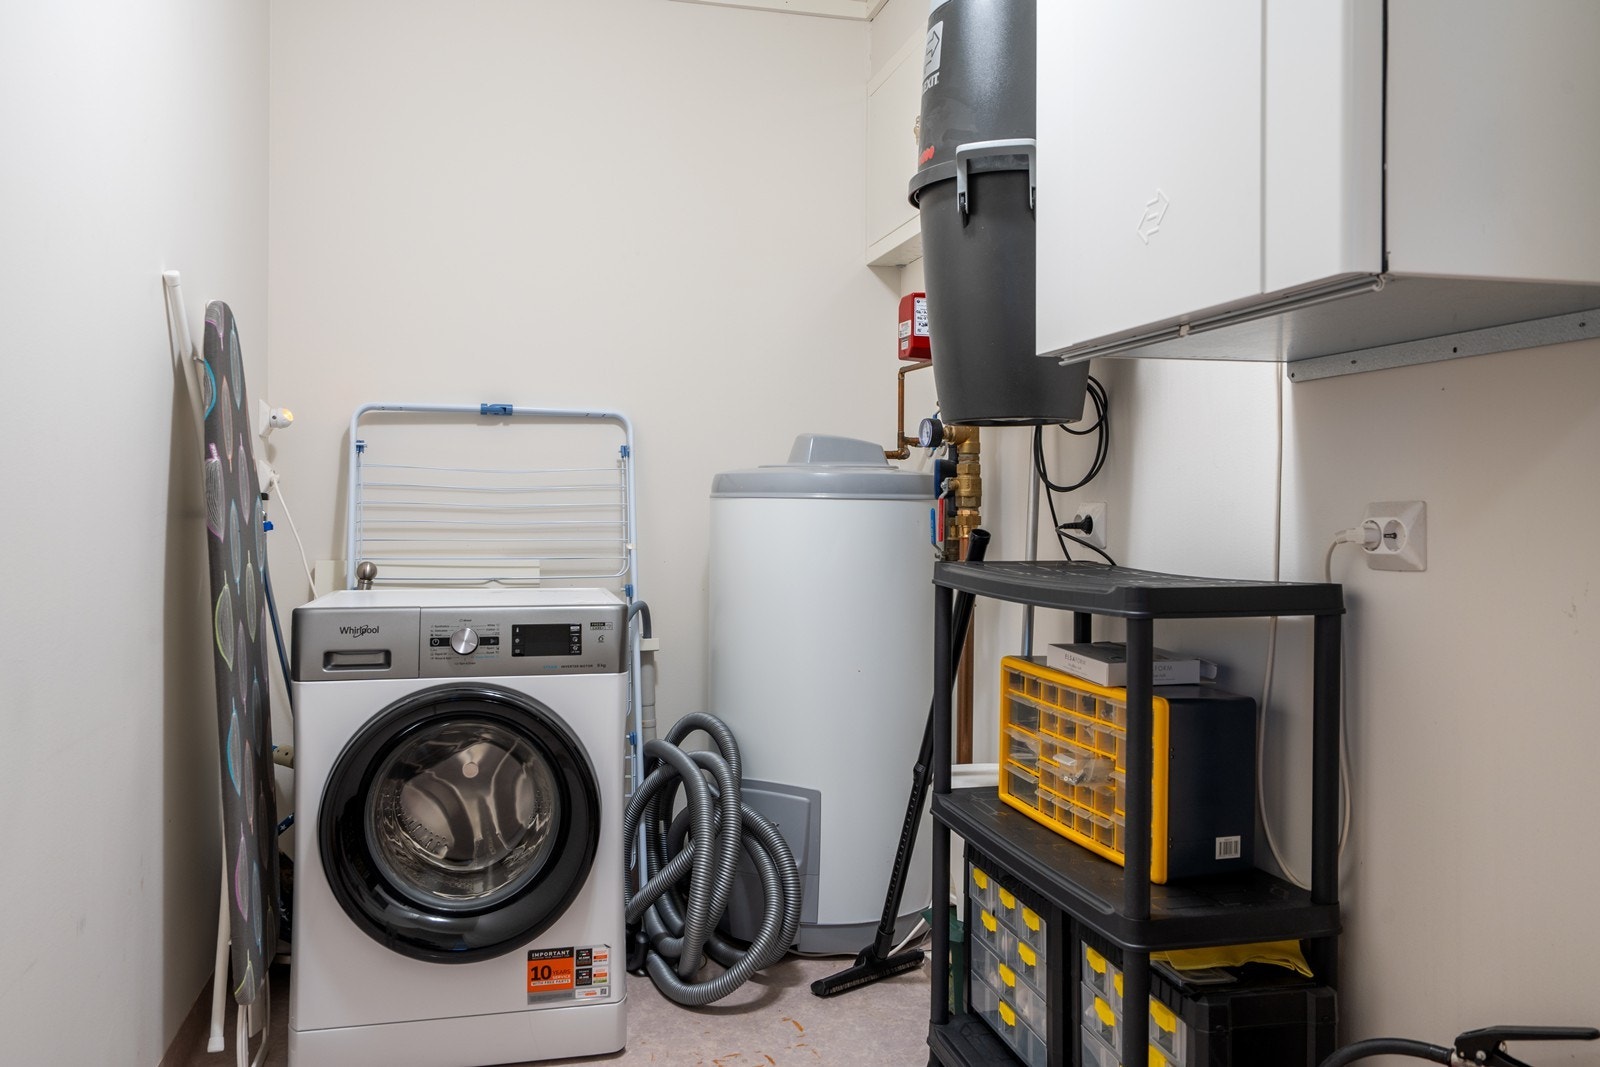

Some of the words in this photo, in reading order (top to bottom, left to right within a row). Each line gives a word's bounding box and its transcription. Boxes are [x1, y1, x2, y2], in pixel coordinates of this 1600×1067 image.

[339, 624, 380, 638] Whirlpool
[532, 950, 570, 958] IMPORTANT
[531, 965, 552, 981] 10
